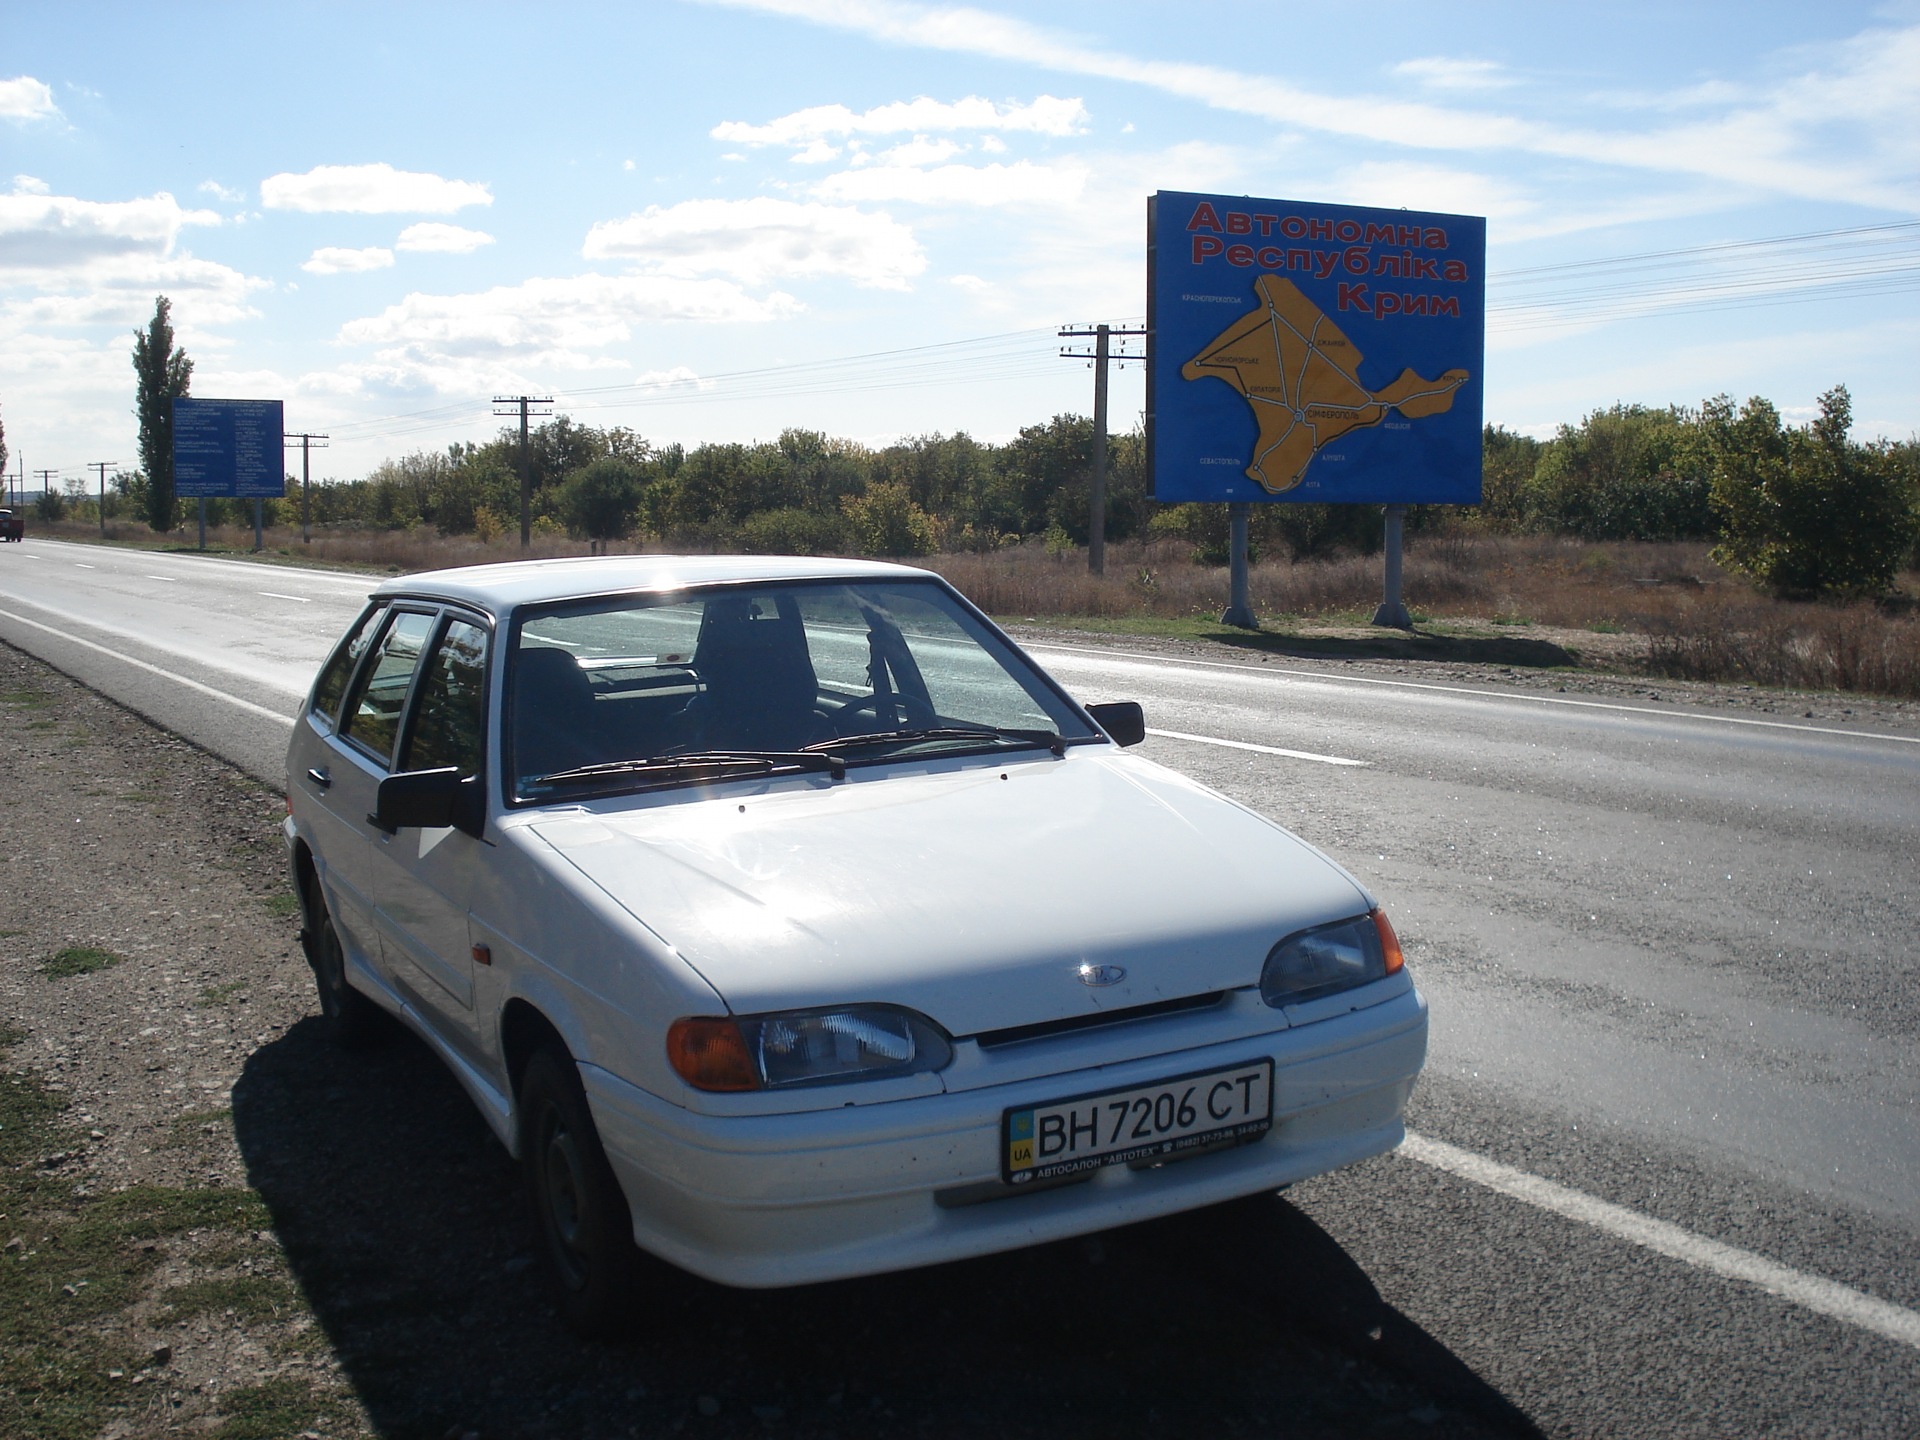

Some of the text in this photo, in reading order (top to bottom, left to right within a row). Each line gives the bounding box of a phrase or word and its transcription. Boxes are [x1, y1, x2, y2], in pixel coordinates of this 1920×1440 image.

[1185, 201, 1449, 250] Автономна
[1191, 234, 1469, 282] Республіка
[1337, 282, 1461, 320] Крим
[1108, 1086, 1197, 1144] 7206
[1014, 1148, 1032, 1162] UA
[1036, 1157, 1101, 1179] АВТОСАЛОН
